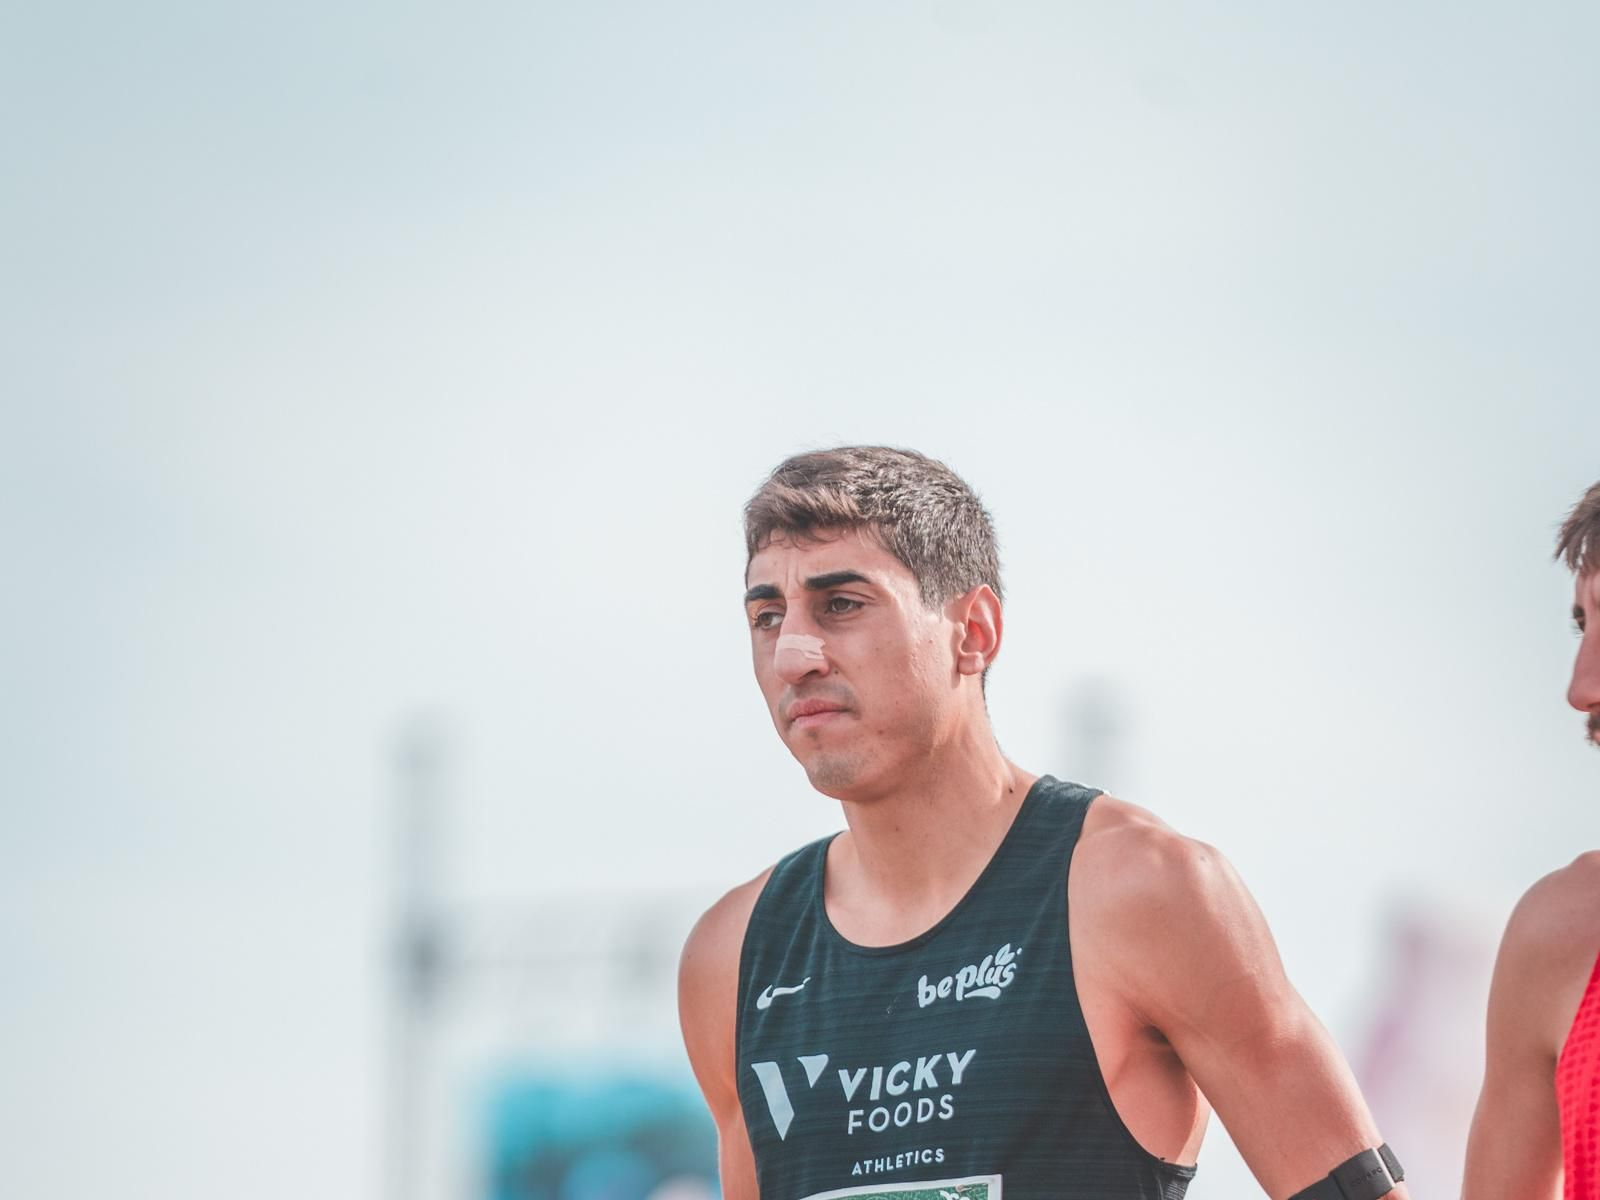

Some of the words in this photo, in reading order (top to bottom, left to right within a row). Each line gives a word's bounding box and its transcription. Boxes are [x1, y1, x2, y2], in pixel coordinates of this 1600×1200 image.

[838, 1049, 976, 1102] VICKY
[848, 1094, 954, 1134] FOODS
[851, 1148, 945, 1176] ATHLETICS
